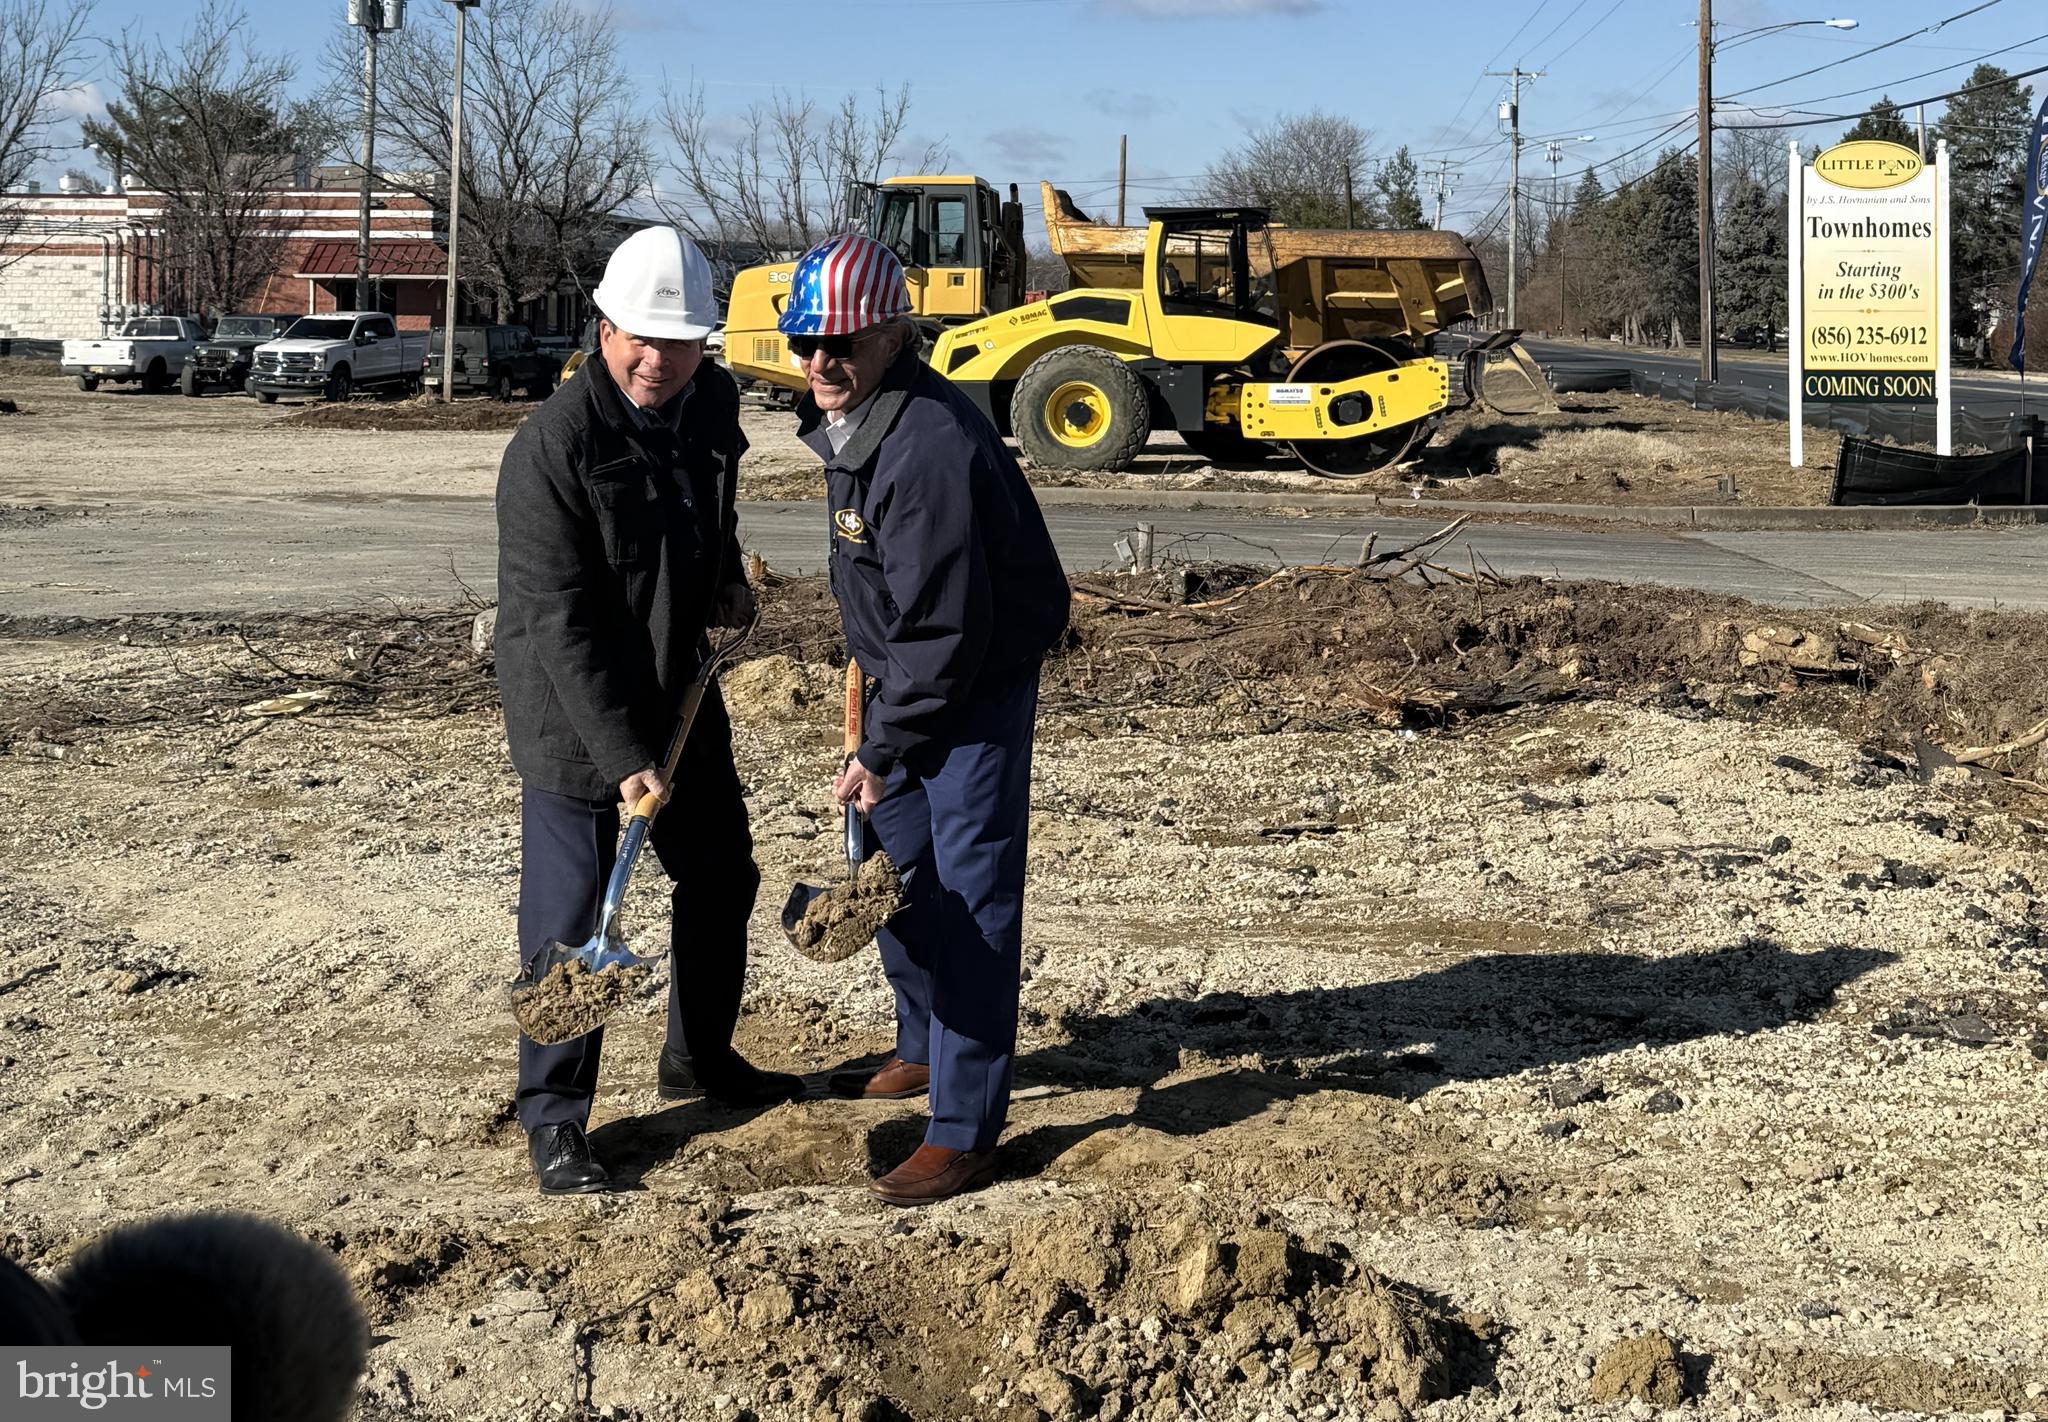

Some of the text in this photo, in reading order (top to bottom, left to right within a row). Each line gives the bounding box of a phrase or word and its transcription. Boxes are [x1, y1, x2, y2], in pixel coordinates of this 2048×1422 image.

[1822, 159, 1874, 170] LITTLE
[1806, 195, 1818, 206] by
[1820, 195, 1836, 204] J.S.
[1890, 195, 1908, 204] and
[1909, 194, 1931, 204] Sons
[1806, 216, 1932, 238] Townhomes
[1835, 261, 1901, 281] Starting
[1818, 282, 1920, 299] in the $300's
[1020, 309, 1048, 321] BOMAG
[1811, 326, 1928, 349] (856) 235-6912
[1810, 352, 1929, 363] www.HOVhomes.com
[1805, 376, 1934, 396] COMING SOON
